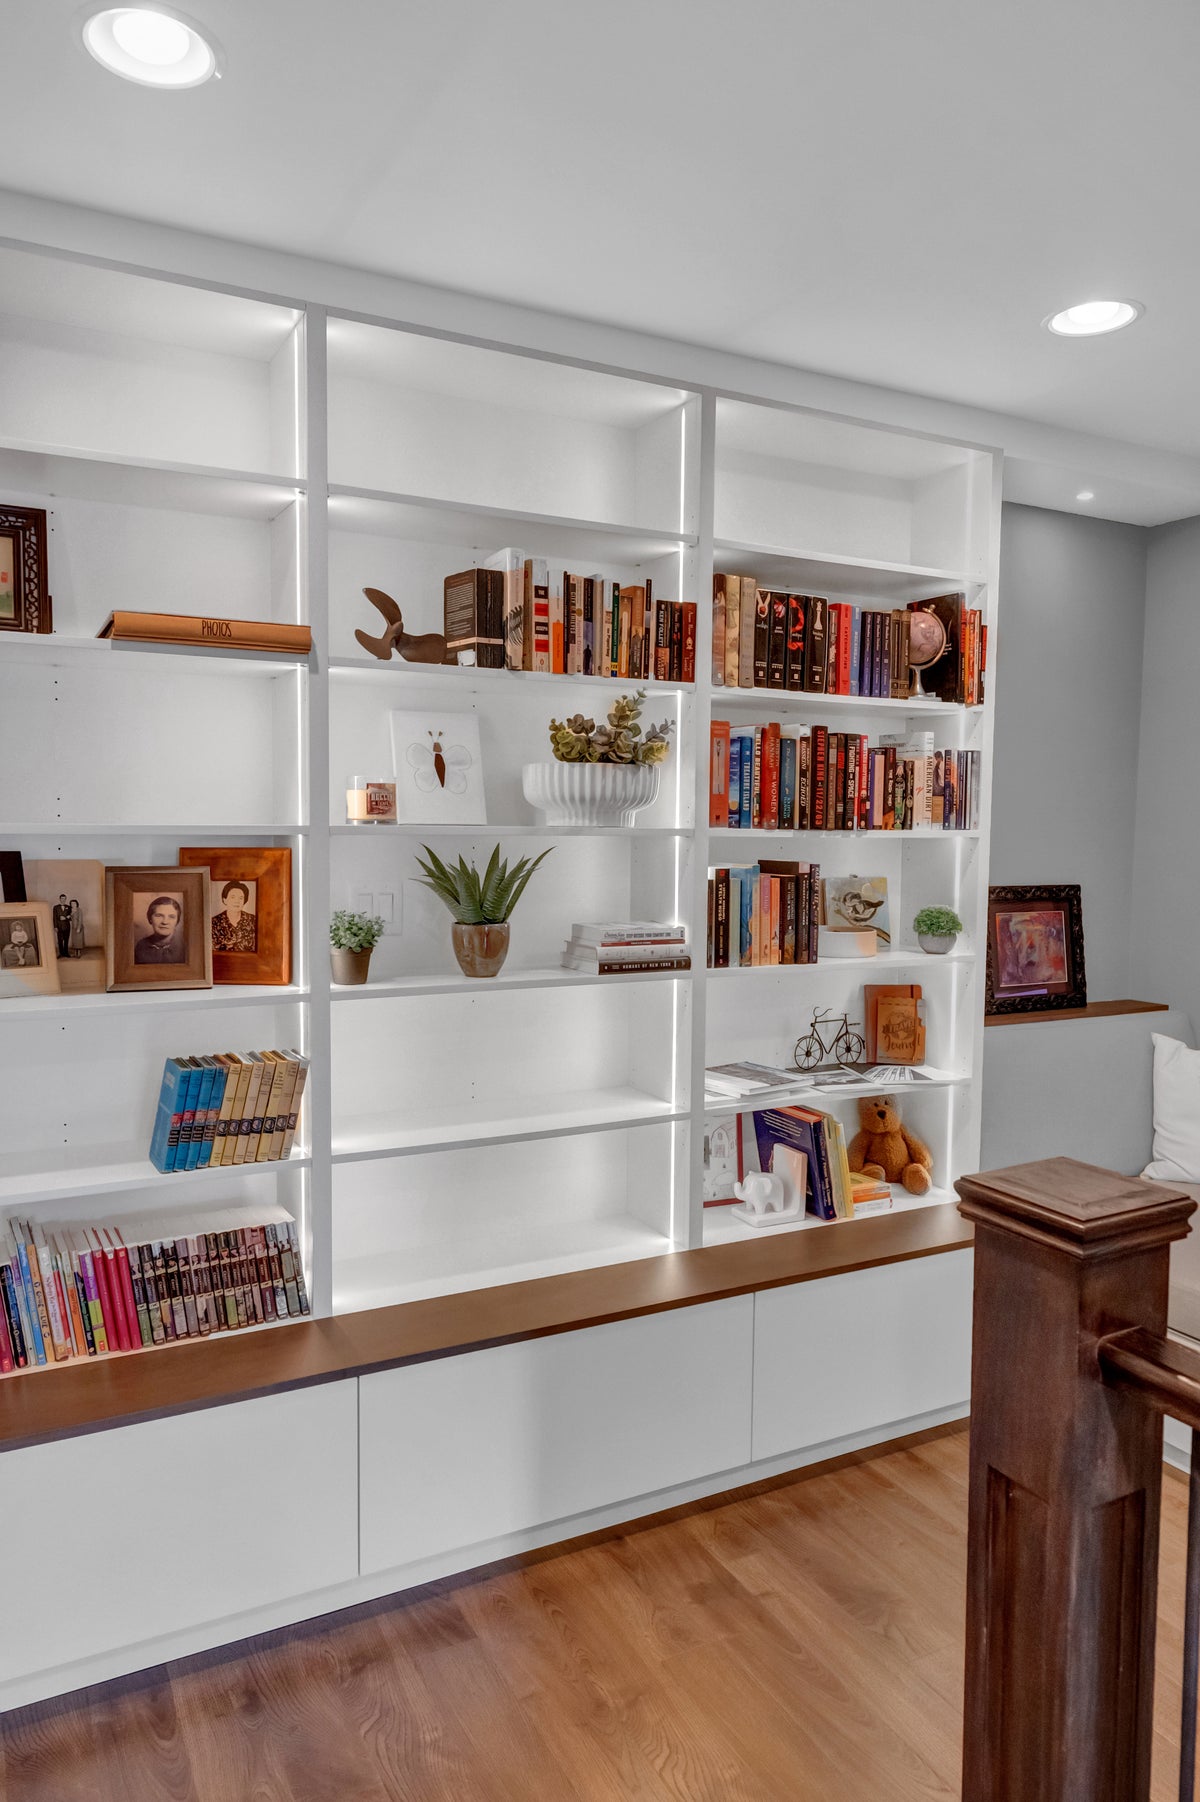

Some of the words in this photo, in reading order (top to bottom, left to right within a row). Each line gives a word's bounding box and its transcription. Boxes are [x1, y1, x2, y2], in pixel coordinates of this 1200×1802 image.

[201, 620, 232, 638] PHOTOS
[816, 730, 825, 762] STEPHEN
[848, 746, 856, 773] FIGHTING
[743, 762, 751, 789] TREASURE
[816, 763, 825, 782] KING
[742, 791, 751, 811] ISLAND
[770, 786, 778, 814] WOMEN
[800, 777, 808, 807] ECHOED
[815, 787, 825, 826] 11/22/63
[39, 1314, 49, 1329] LIFE
